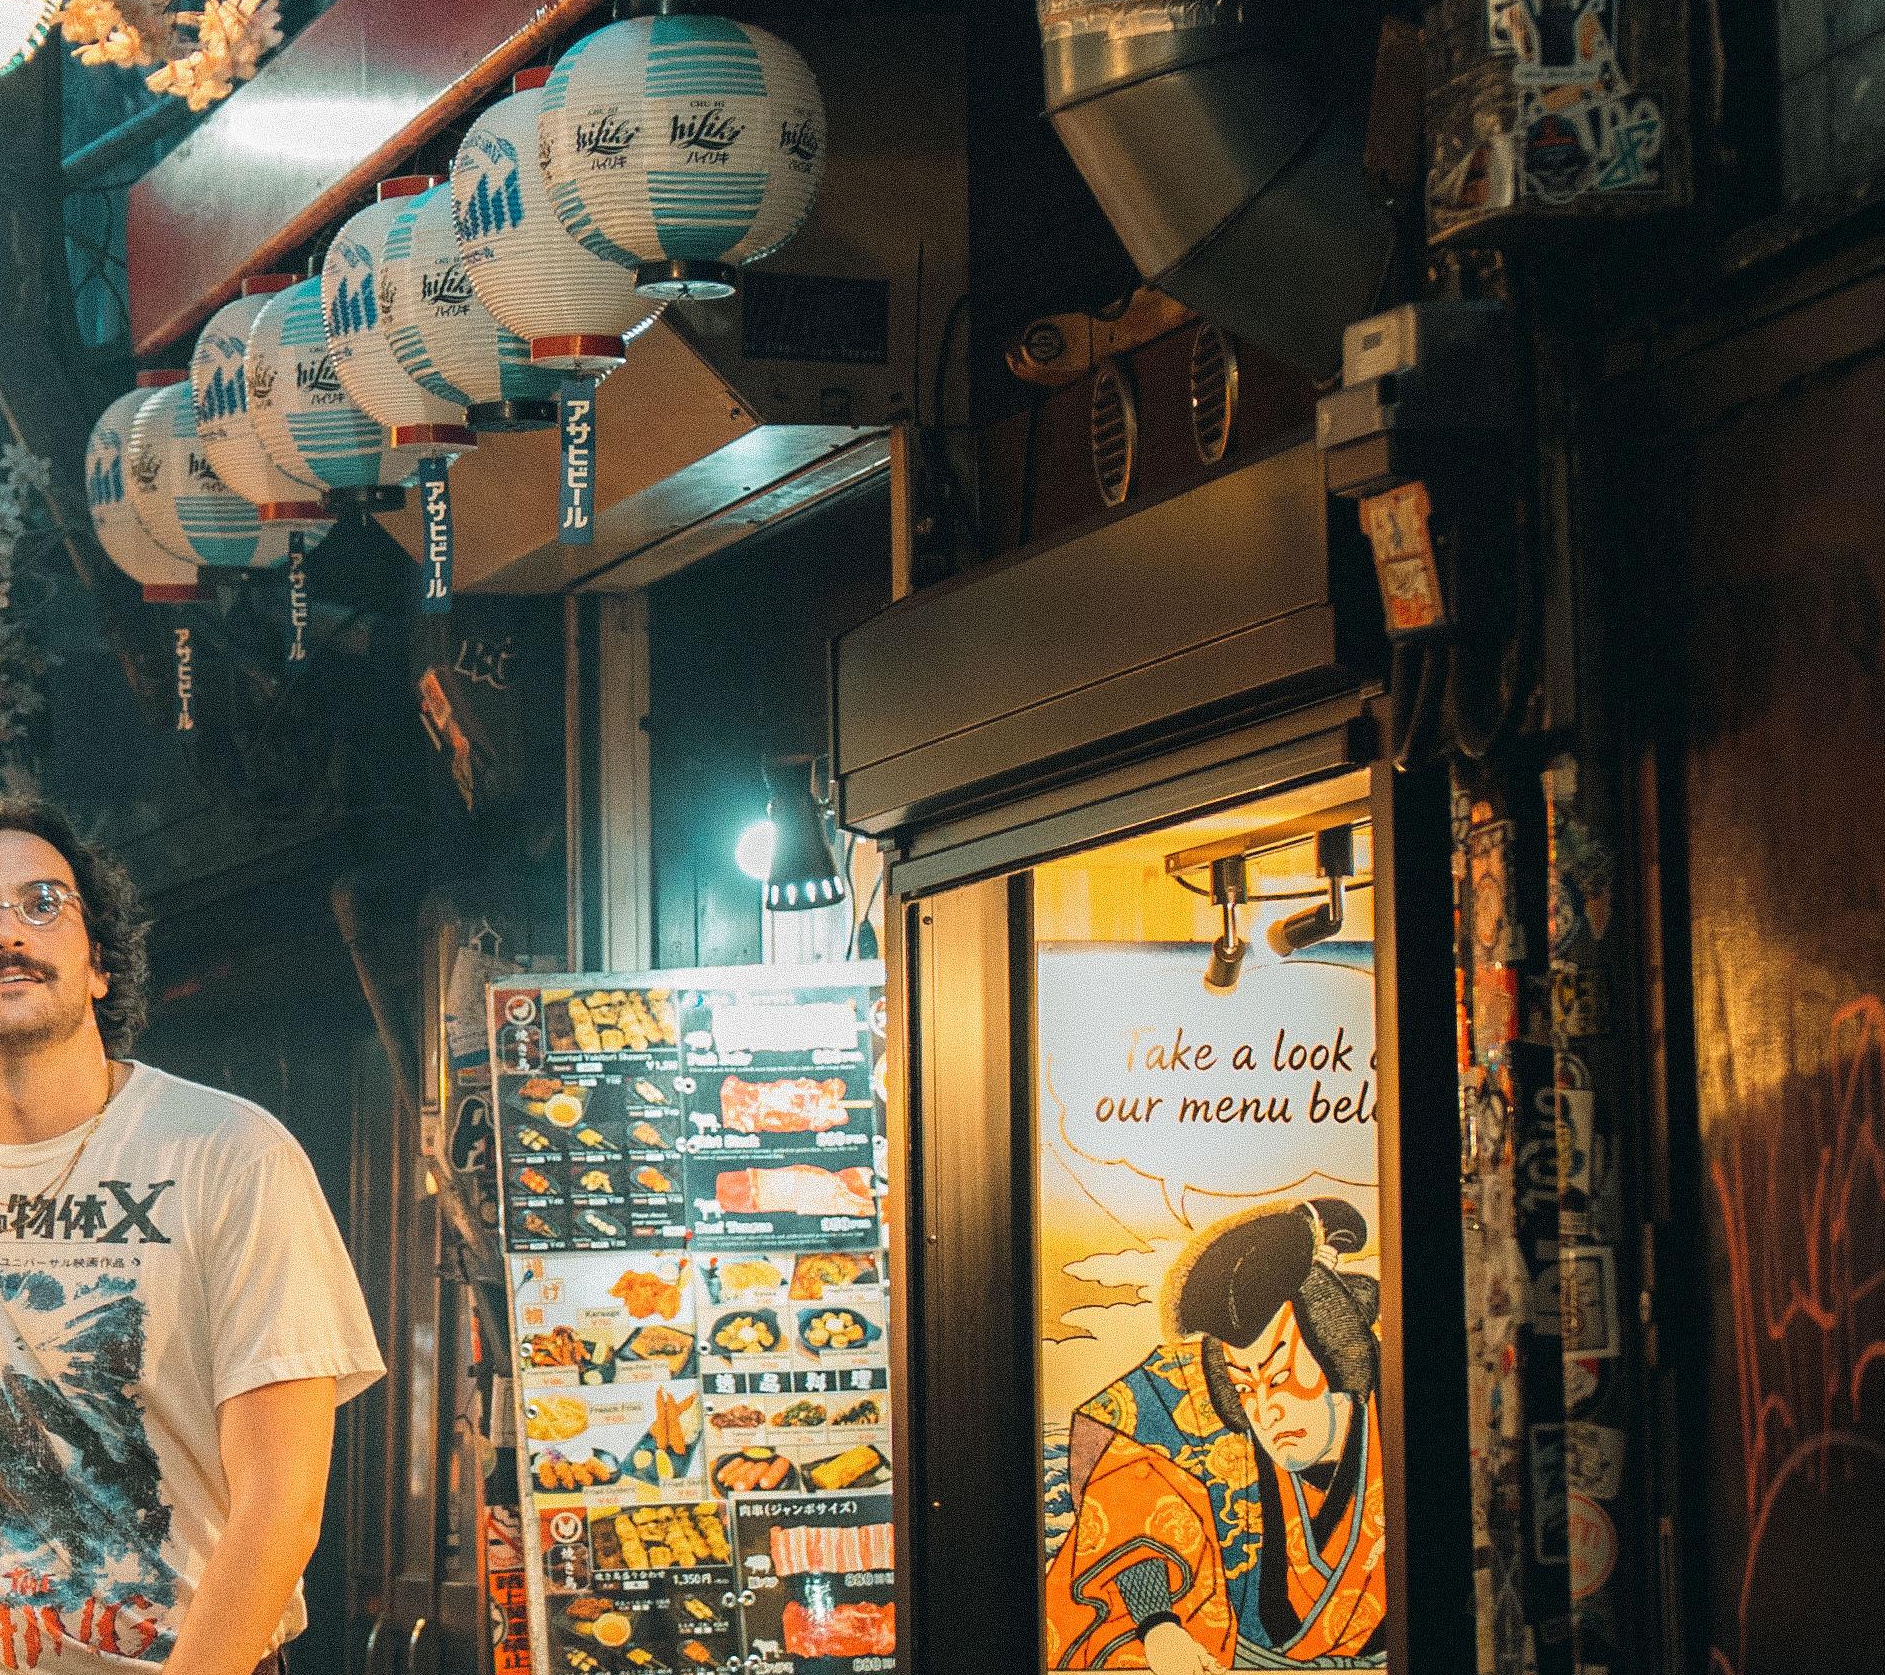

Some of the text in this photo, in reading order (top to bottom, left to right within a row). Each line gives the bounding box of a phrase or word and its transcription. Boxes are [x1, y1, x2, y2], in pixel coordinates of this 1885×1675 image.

[563, 400, 591, 528] アサヒビール
[425, 481, 447, 599] アサヒビール
[1123, 1026, 1217, 1072] Take
[1231, 1044, 1257, 1071] a
[1273, 1027, 1354, 1072] look
[1095, 1096, 1163, 1123] our
[1178, 1096, 1292, 1124] menu
